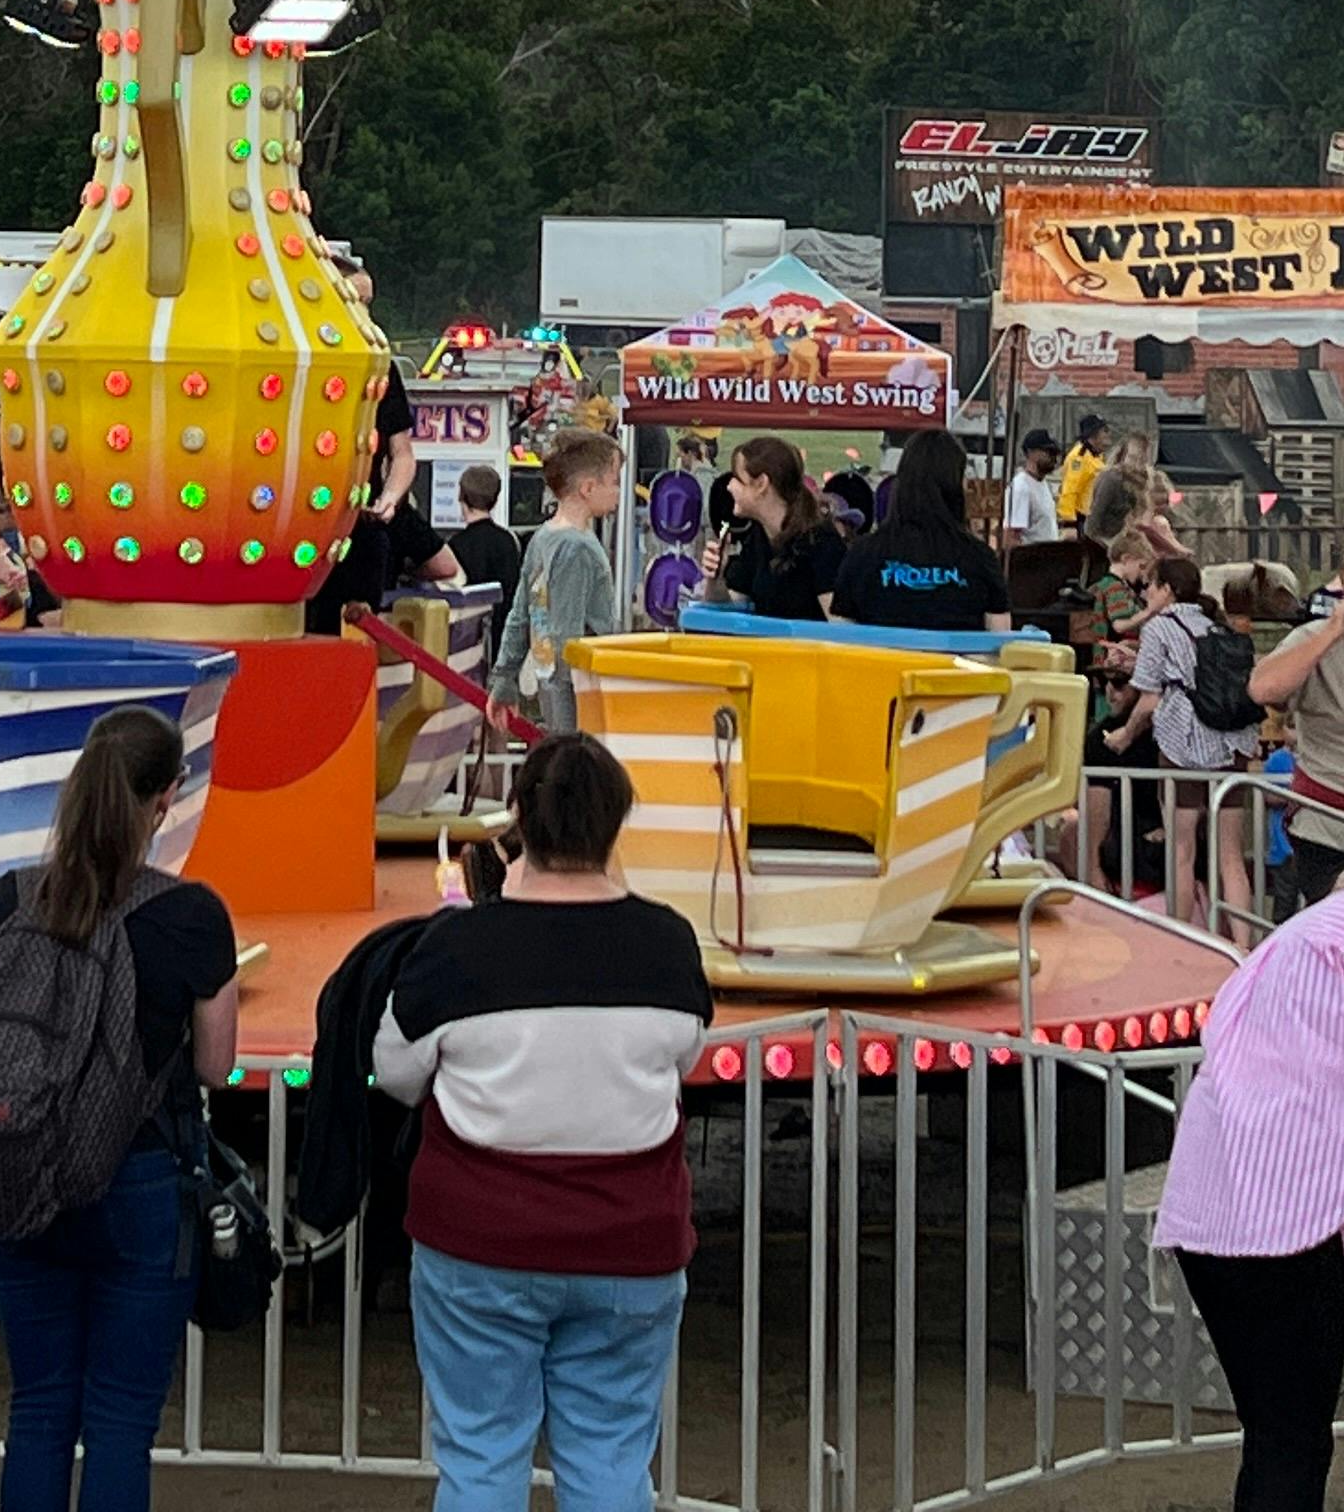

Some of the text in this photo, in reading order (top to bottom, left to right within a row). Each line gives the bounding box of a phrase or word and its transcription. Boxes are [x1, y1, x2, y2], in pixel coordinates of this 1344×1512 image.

[895, 160, 1153, 179] FREESTYLE ENTERTAINMENT
[911, 174, 984, 217] RANDY
[1067, 219, 1235, 262] WILD
[1129, 255, 1301, 298] WEST
[636, 375, 937, 414] Wild Wild West Swing
[409, 404, 490, 444] ETS
[880, 561, 959, 589] FROZEN
